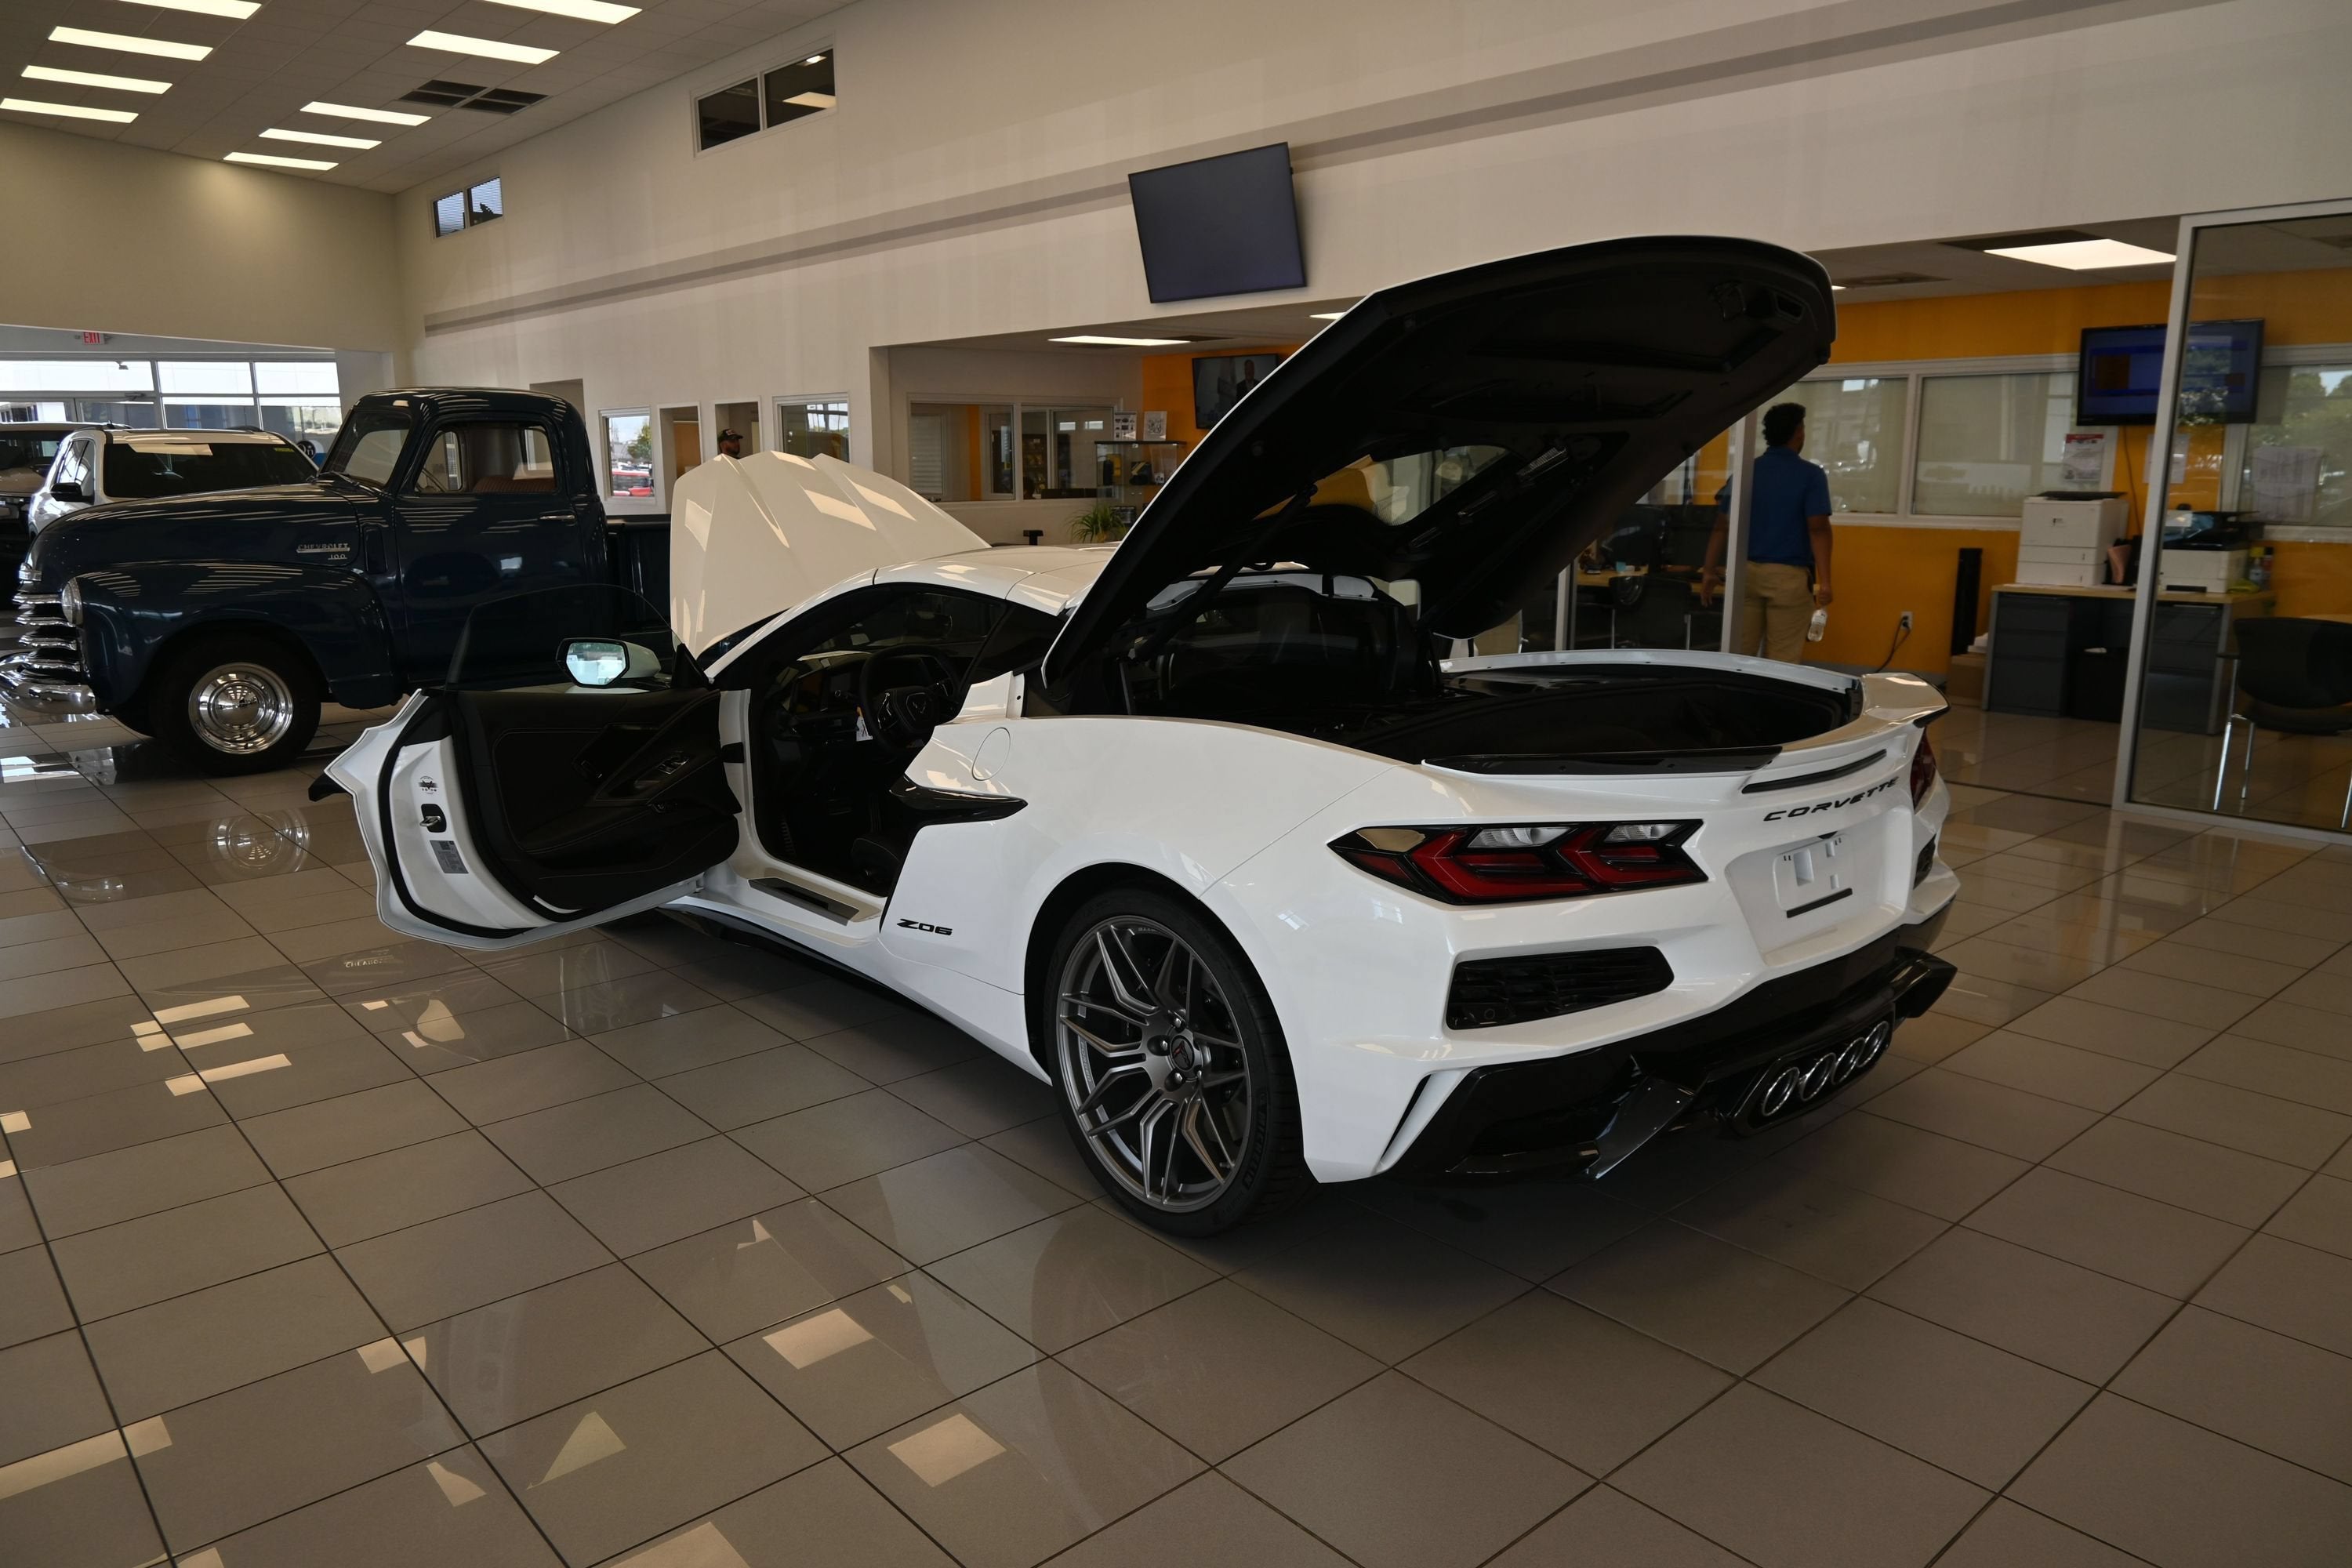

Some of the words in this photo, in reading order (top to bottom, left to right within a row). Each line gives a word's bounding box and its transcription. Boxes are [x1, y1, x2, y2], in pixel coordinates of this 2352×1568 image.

[83, 332, 100, 343] EXIT
[1763, 776, 1899, 822] CORVETTE
[896, 918, 953, 936] Z06
